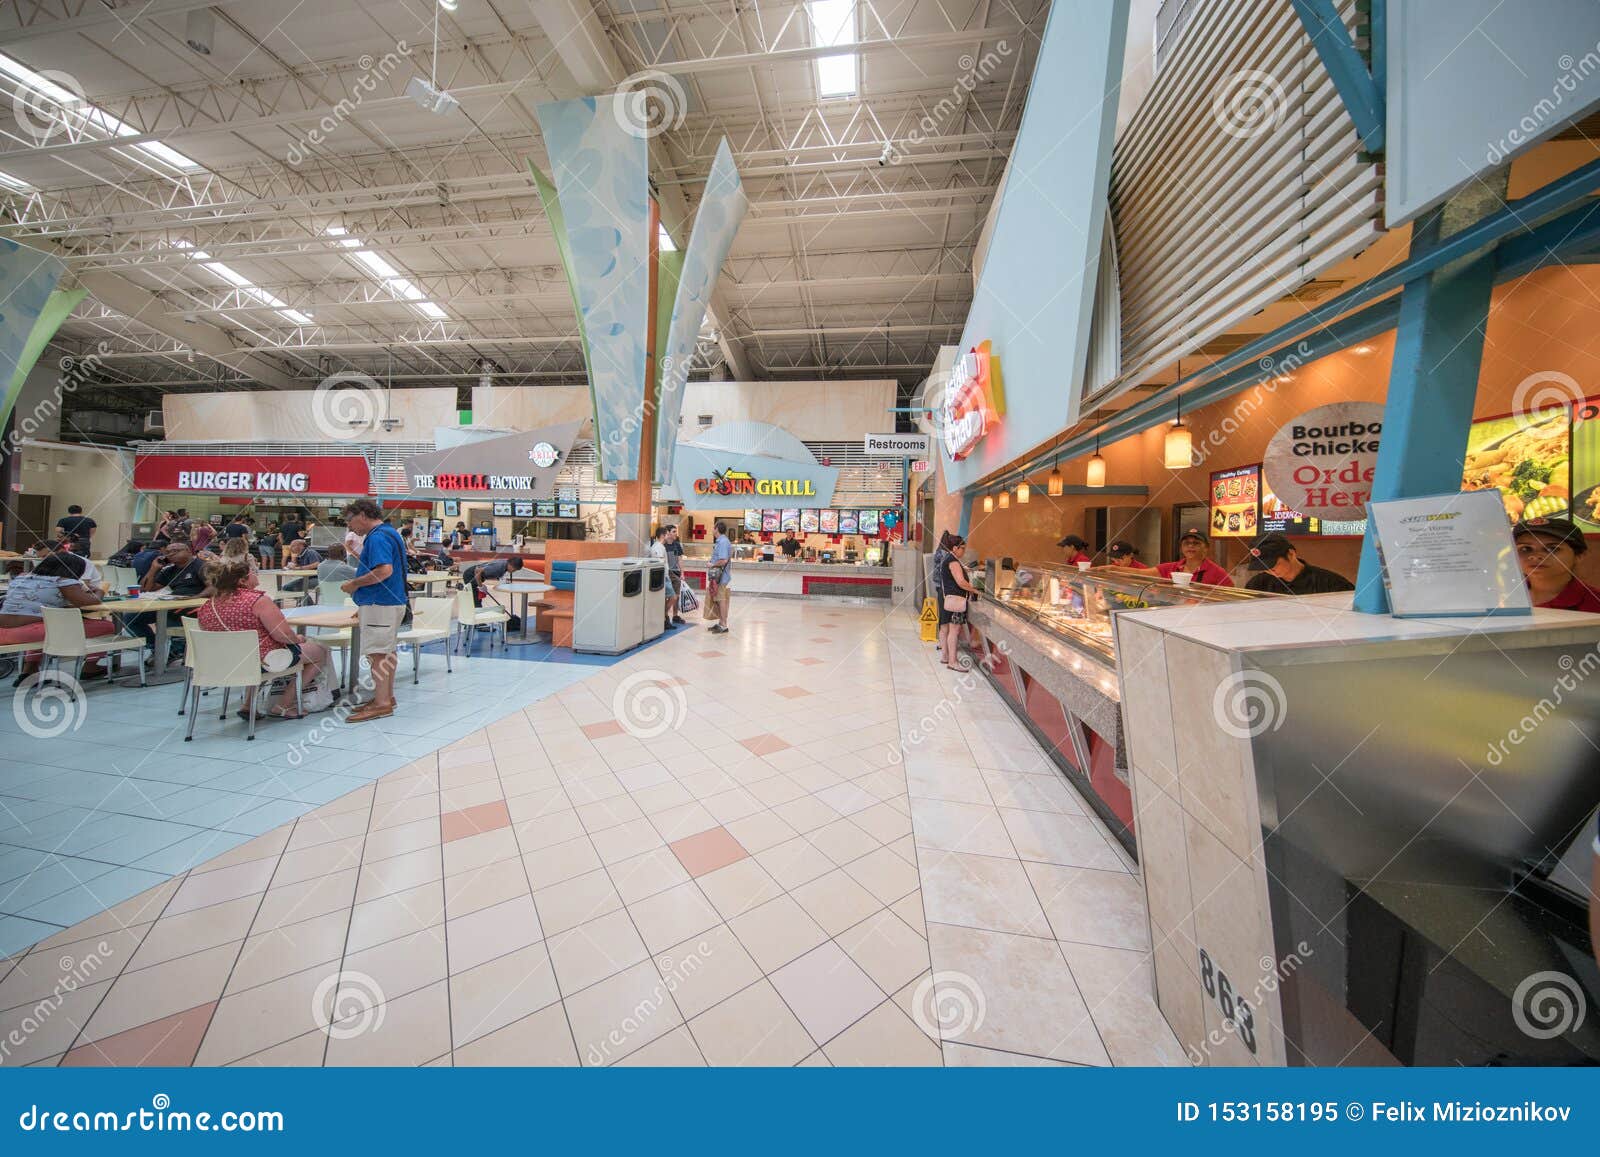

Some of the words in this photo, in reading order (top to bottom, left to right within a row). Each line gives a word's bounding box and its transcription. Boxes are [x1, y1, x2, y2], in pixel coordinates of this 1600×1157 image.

[869, 439, 925, 449] Restrooms
[178, 471, 252, 489] BURGER
[256, 472, 308, 491] KING
[414, 475, 435, 488] THE
[436, 474, 488, 490] GRILL
[490, 476, 533, 489] FACTORY
[756, 480, 816, 496] GRILL
[1304, 488, 1372, 507] Her
